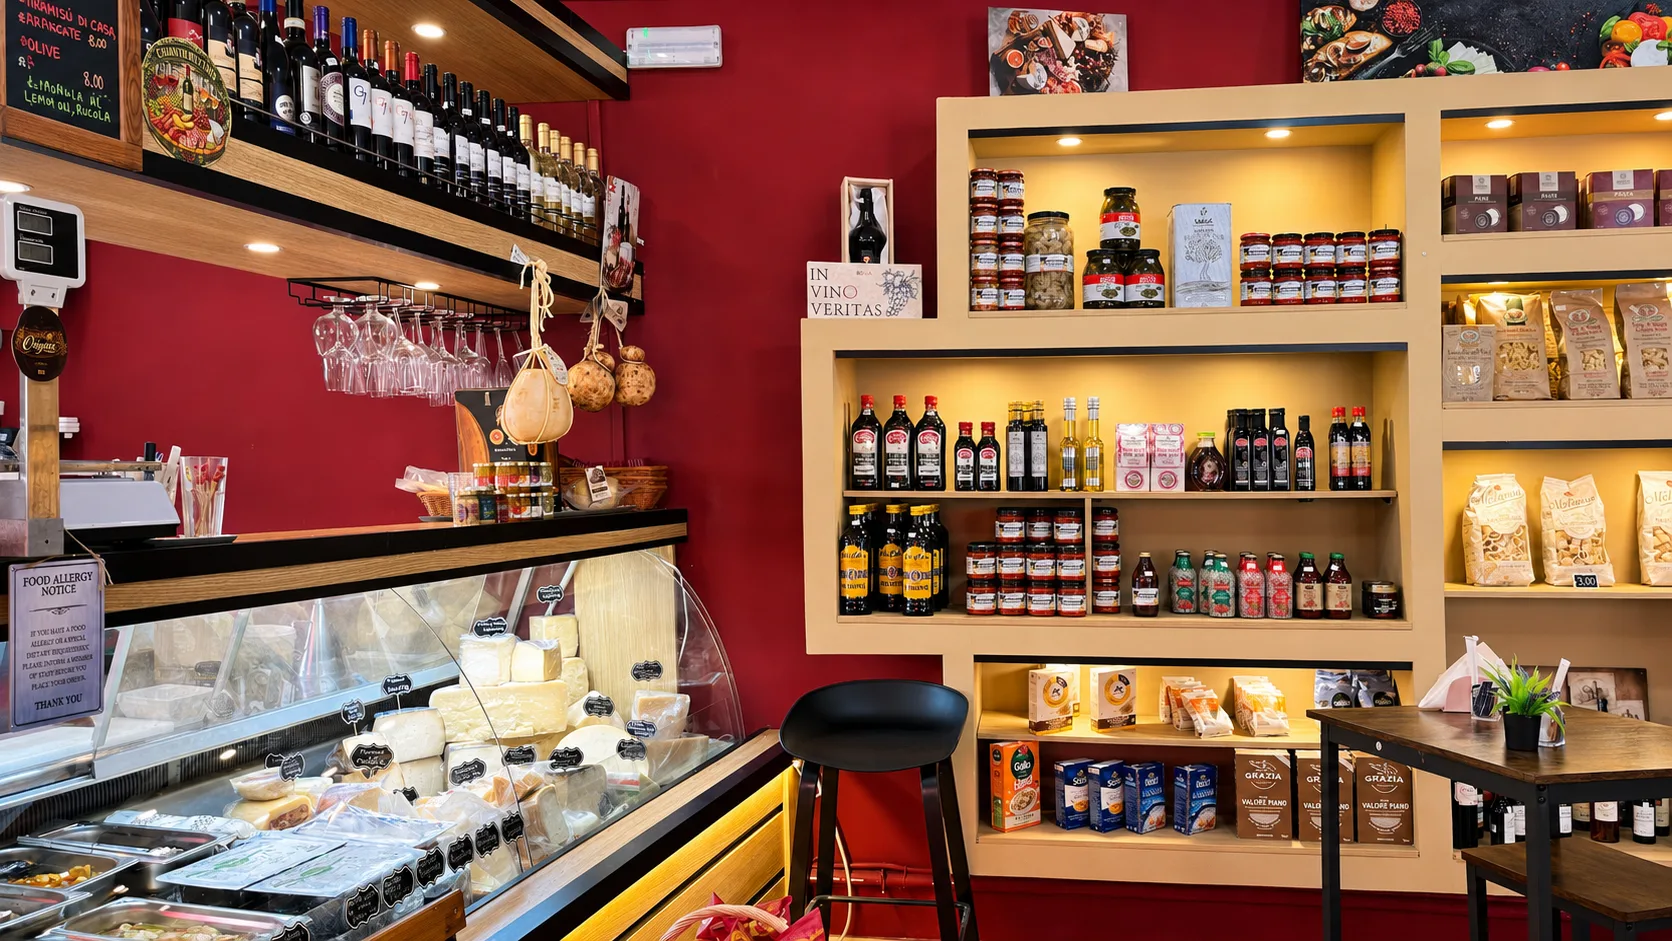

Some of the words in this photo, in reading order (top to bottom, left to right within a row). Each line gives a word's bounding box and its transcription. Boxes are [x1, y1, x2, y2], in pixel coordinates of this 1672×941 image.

[77, 14, 88, 27] DI
[83, 71, 104, 90] 8.00
[76, 103, 111, 123] RUCOLA
[810, 268, 828, 281] IN
[811, 285, 858, 299] VINO
[811, 303, 882, 317] VERITAS
[23, 575, 51, 588] FOOD
[53, 571, 93, 585] ALLERGY
[1577, 576, 1595, 586] 3.00
[41, 584, 76, 596] NOTICE
[35, 698, 64, 711] THANK
[65, 693, 83, 704] YOU
